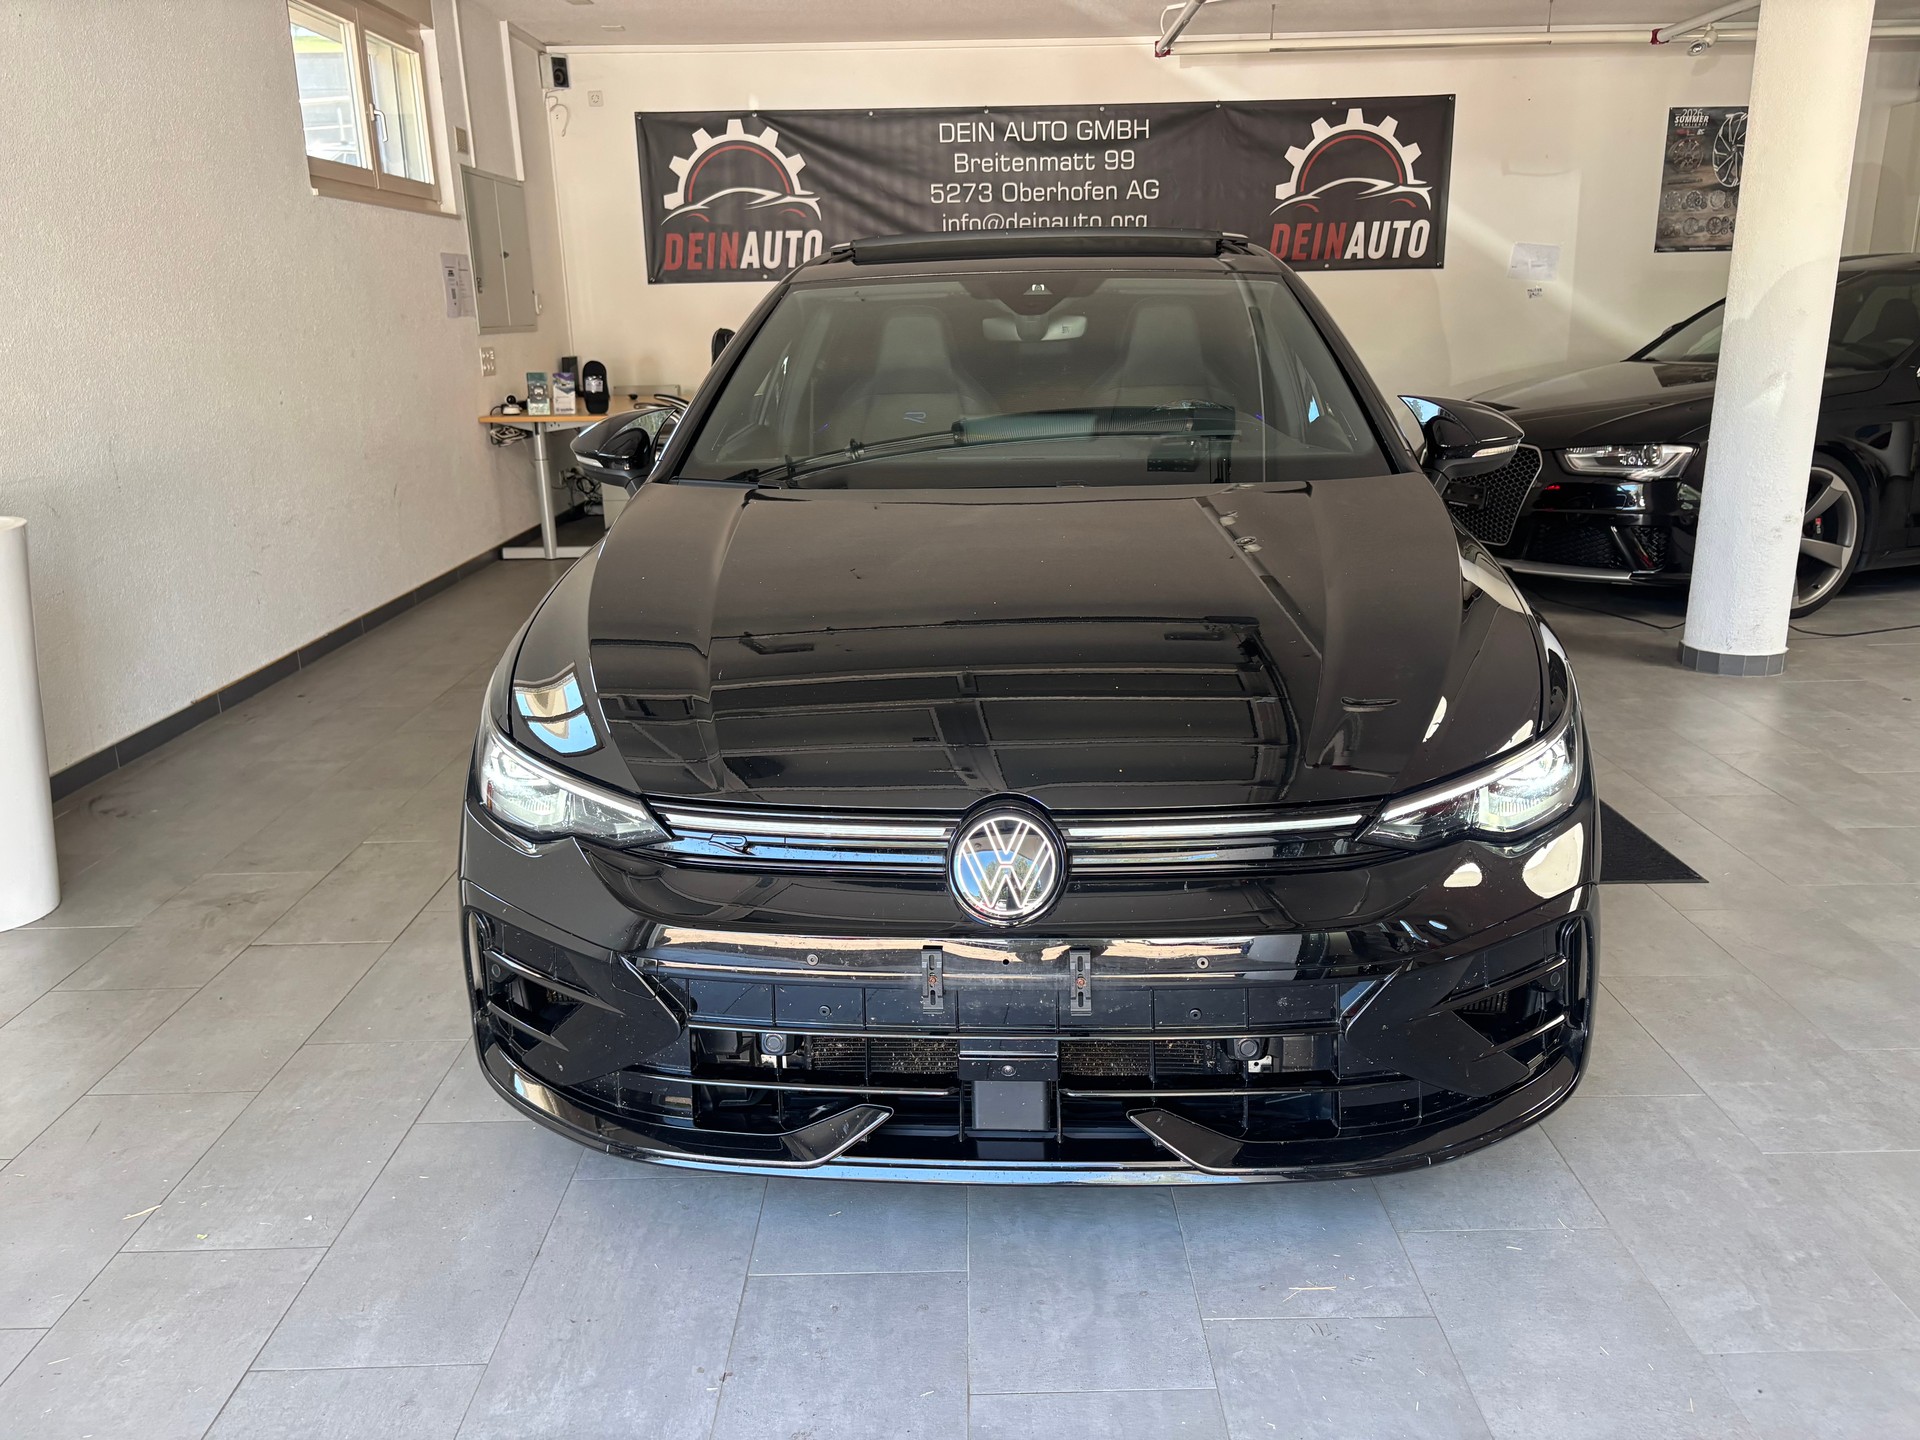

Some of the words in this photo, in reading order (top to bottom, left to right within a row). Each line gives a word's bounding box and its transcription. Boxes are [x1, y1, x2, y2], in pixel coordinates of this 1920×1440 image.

[938, 122, 995, 143] DEIN
[1004, 121, 1068, 142] AUTO
[1076, 119, 1150, 141] GMBH
[1674, 115, 1709, 123] SOMMER
[953, 152, 1096, 173] Breitenmatt
[1104, 150, 1135, 170] 99
[930, 183, 993, 204] 5273
[1002, 181, 1118, 202] Oberhofen
[1126, 179, 1160, 200] AG
[942, 212, 1148, 232] info@deinautoorg
[663, 229, 823, 271] DEINAUTO
[1268, 219, 1431, 261] DEINAUTO
